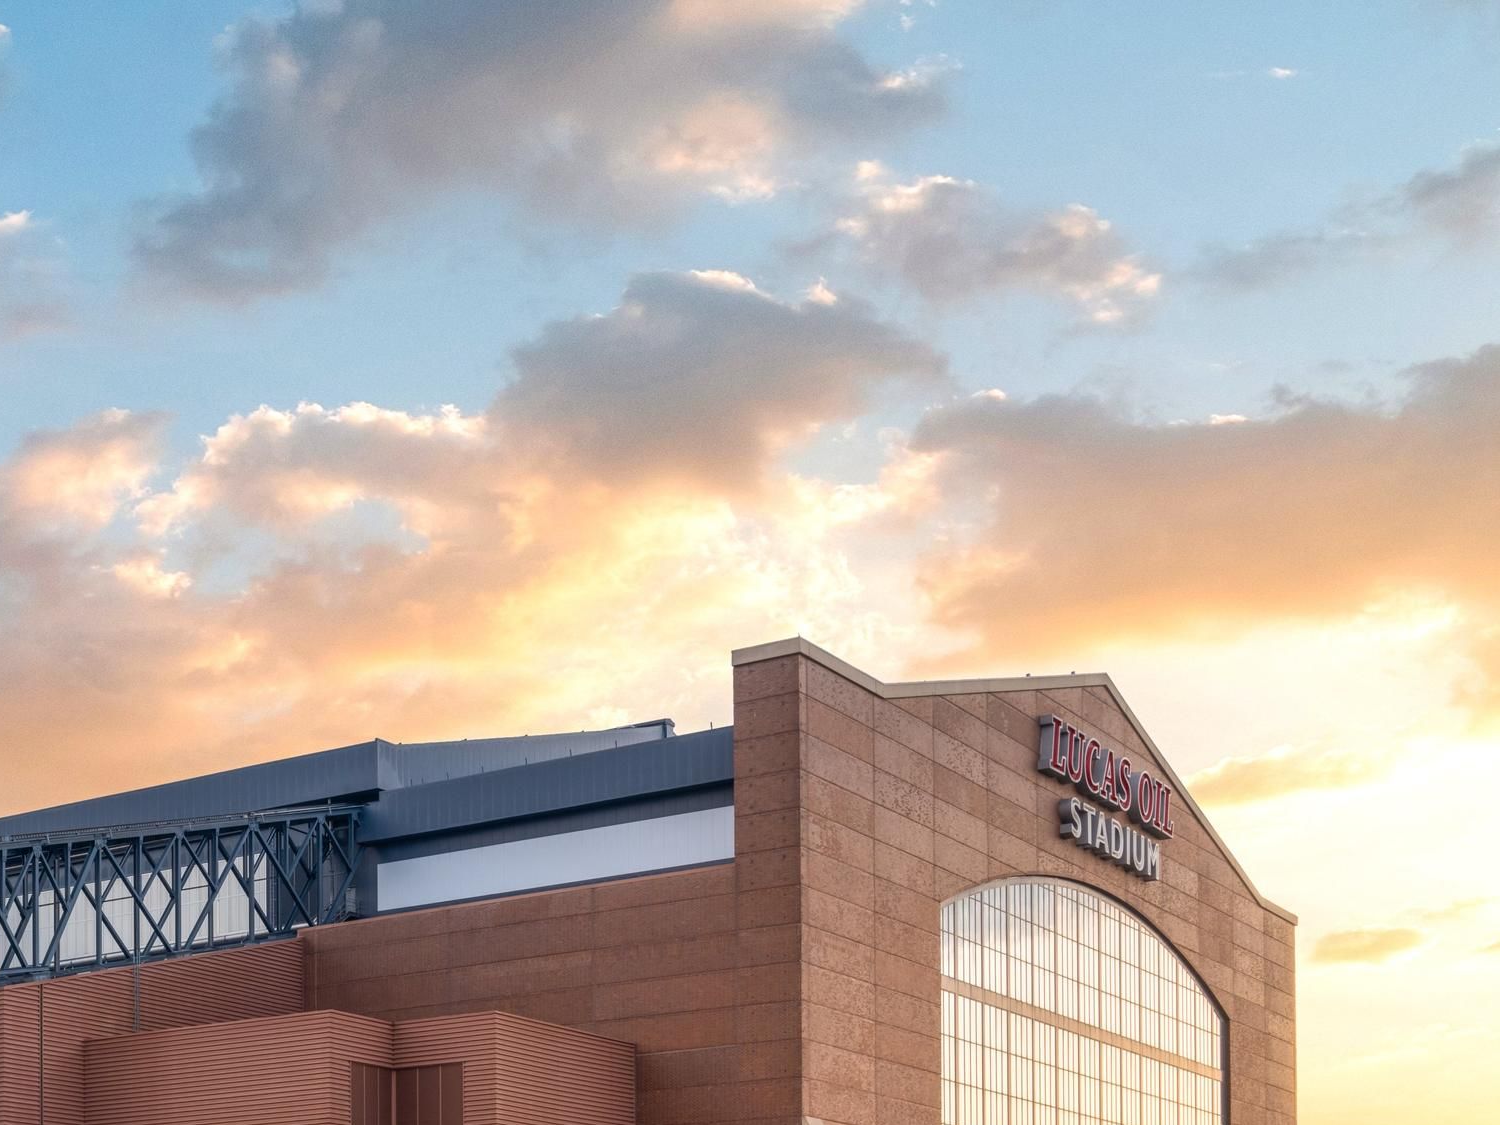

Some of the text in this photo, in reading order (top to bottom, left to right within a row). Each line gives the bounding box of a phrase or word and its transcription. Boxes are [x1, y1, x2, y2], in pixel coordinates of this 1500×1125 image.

[1050, 715, 1174, 839] LUCAS OIL
[1070, 797, 1160, 881] STADIUM
